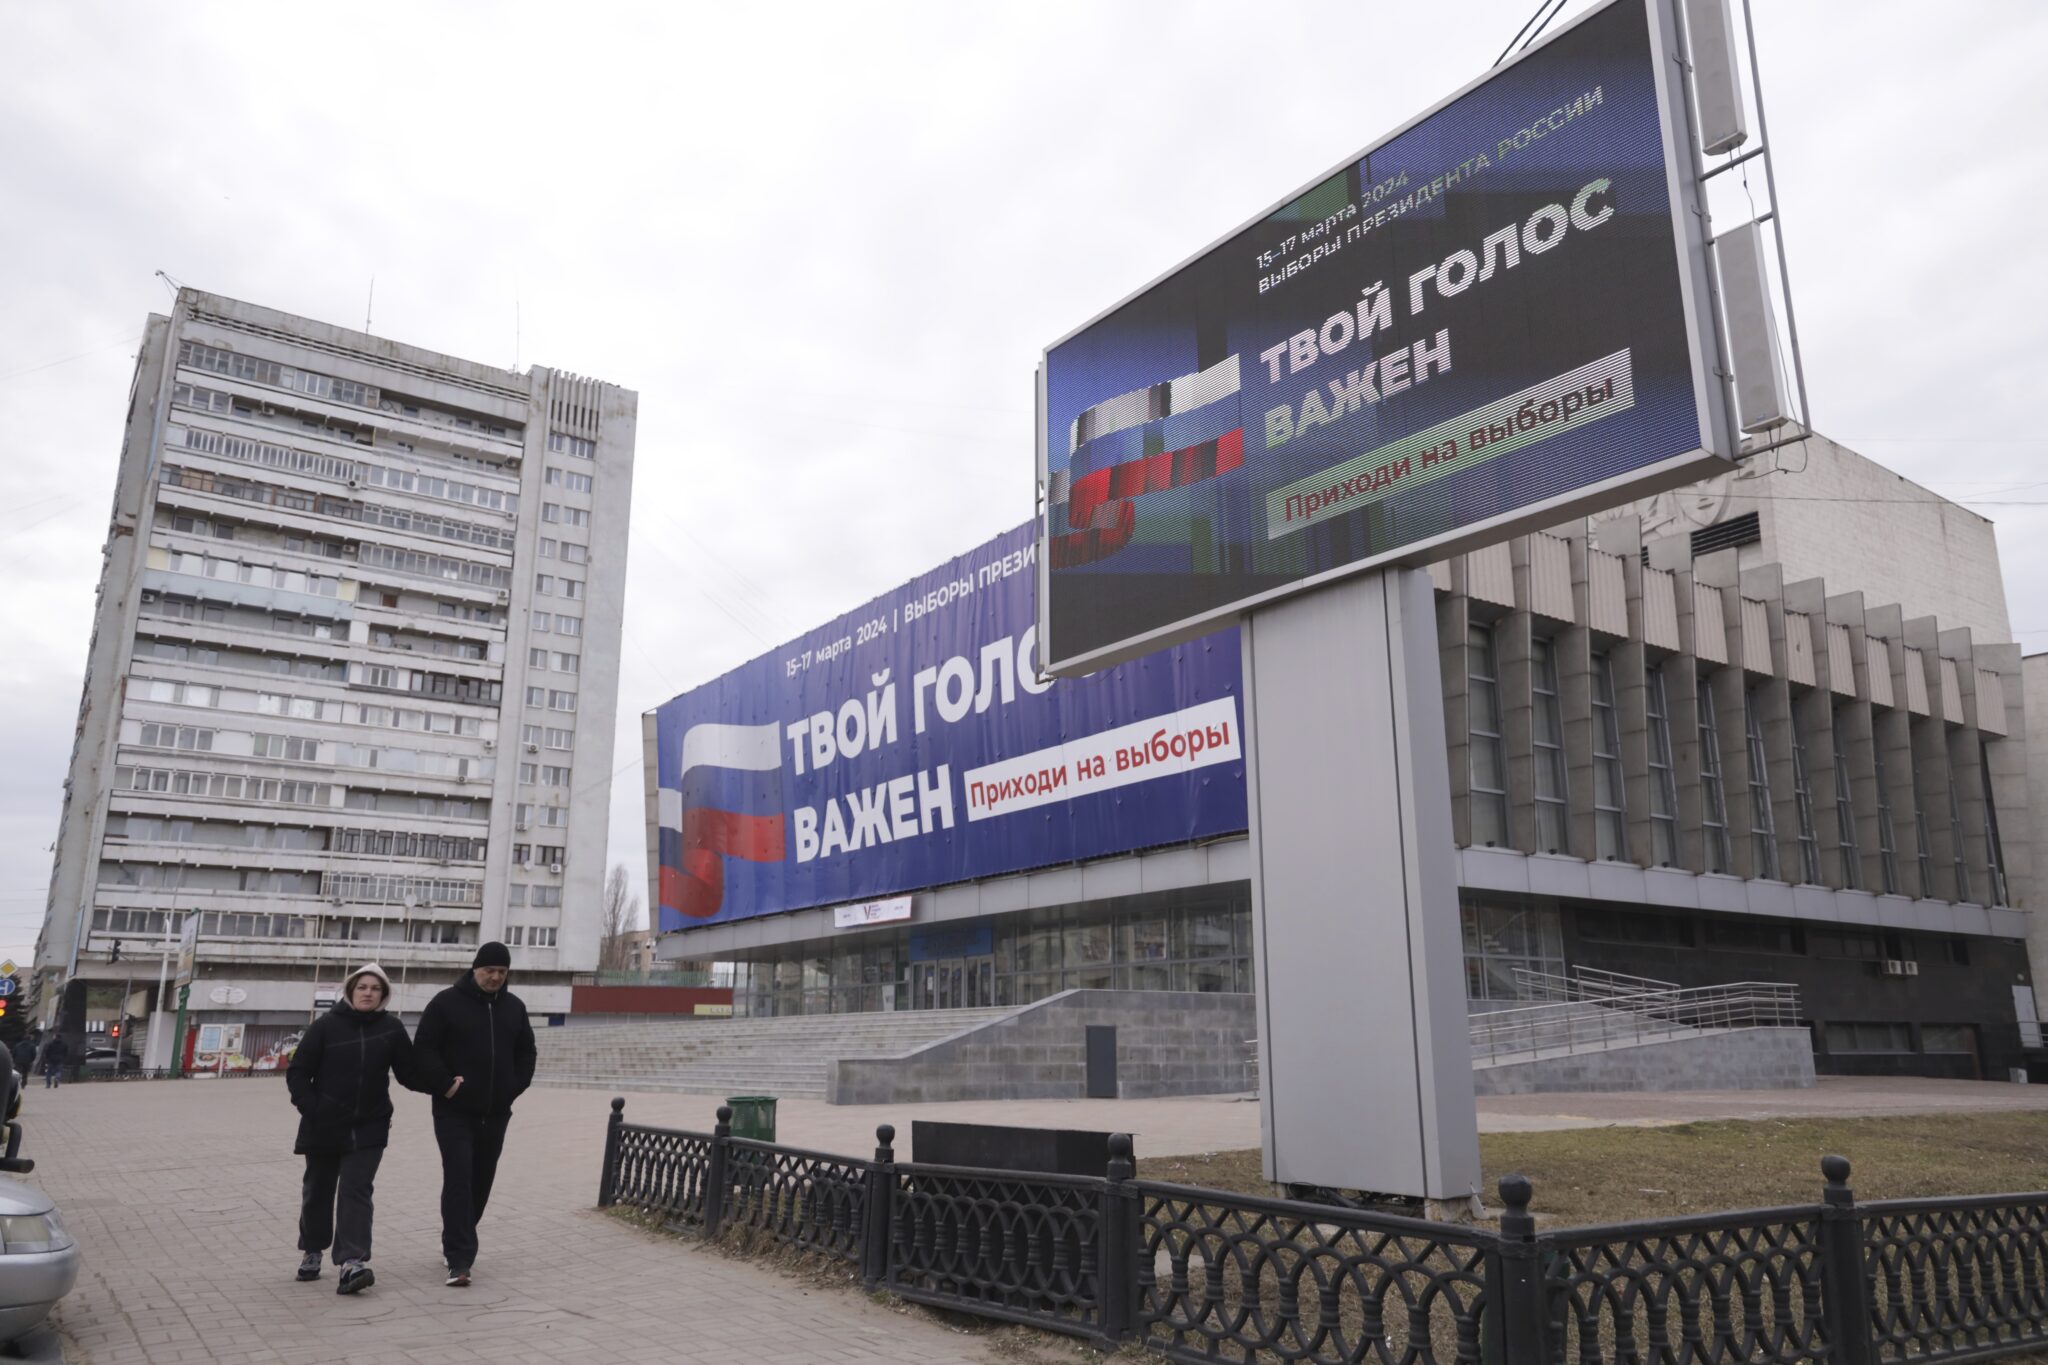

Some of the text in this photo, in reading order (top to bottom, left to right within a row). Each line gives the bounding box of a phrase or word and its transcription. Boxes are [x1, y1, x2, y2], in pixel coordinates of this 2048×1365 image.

[1258, 85, 1604, 294] ВЫБОРЫ ПРЕЗИДЕНТА РОССИИ
[1301, 203, 1357, 245] марта
[1361, 170, 1409, 208] 2024
[1260, 177, 1615, 385] ТВОЙ ГОЛОС
[1263, 327, 1452, 450] ВАЖЕН
[1284, 376, 1616, 522] Приходи на выборы
[815, 635, 852, 664] марта
[856, 615, 888, 646] 2024
[904, 573, 974, 625] ВЫБОРЫ
[979, 542, 1036, 589] ПРЕЗИ
[786, 667, 898, 776] ТВОЙ
[970, 721, 1231, 811] Приходи на выборы
[793, 763, 955, 864] ВАЖЕН
